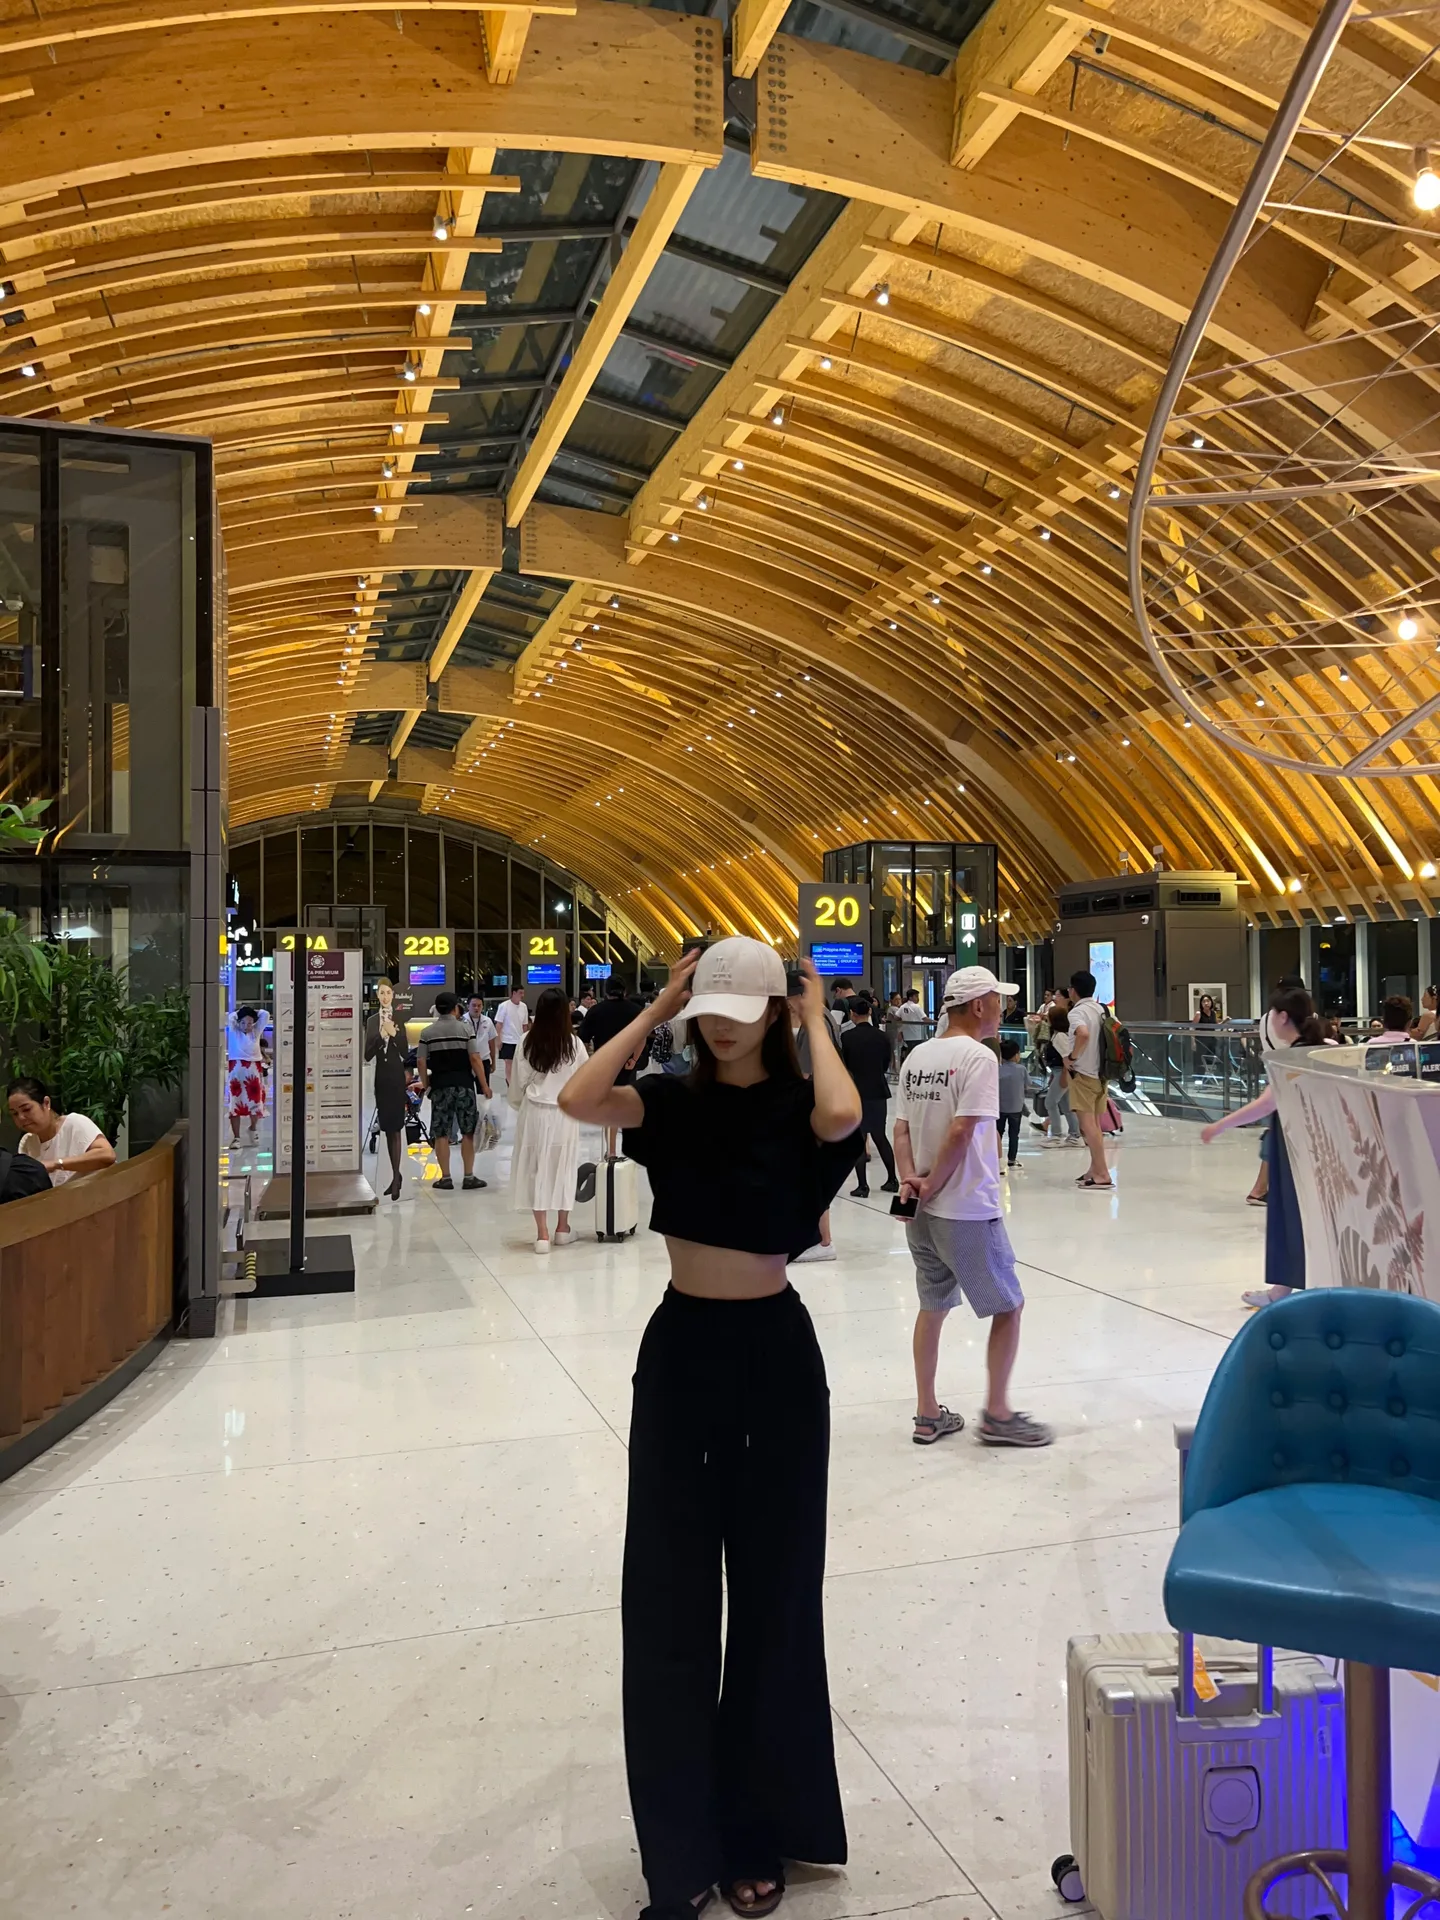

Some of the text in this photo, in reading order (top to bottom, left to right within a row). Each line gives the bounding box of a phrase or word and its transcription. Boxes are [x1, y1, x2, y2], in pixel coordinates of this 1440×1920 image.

[814, 895, 860, 927] 20
[403, 936, 450, 955] 22B
[529, 936, 559, 955] 21
